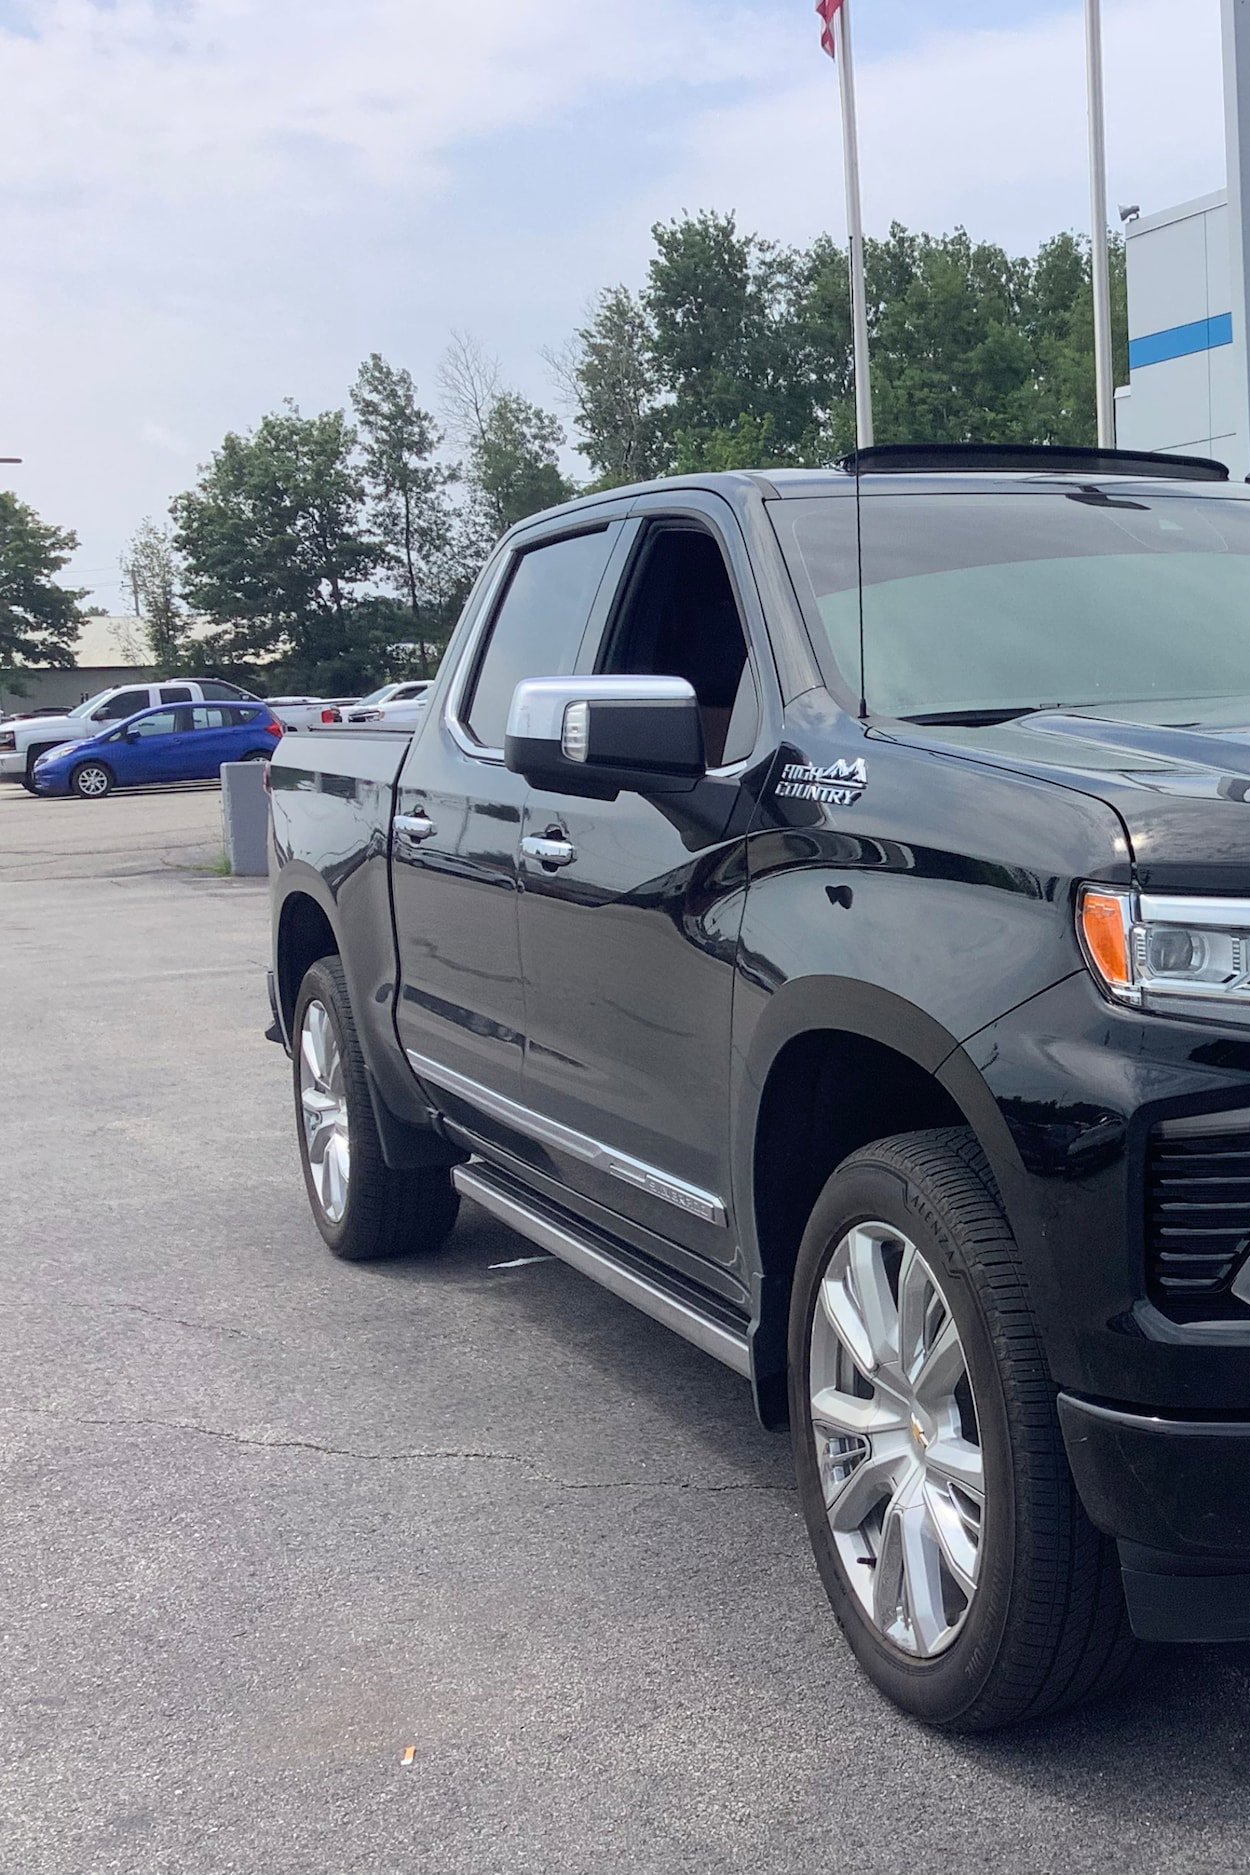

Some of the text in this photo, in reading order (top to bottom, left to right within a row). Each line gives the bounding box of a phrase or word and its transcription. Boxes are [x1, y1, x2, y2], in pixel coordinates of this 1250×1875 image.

[781, 763, 824, 780] HIGH
[775, 781, 861, 806] COUNTRY
[911, 1195, 955, 1262] ALENZA
